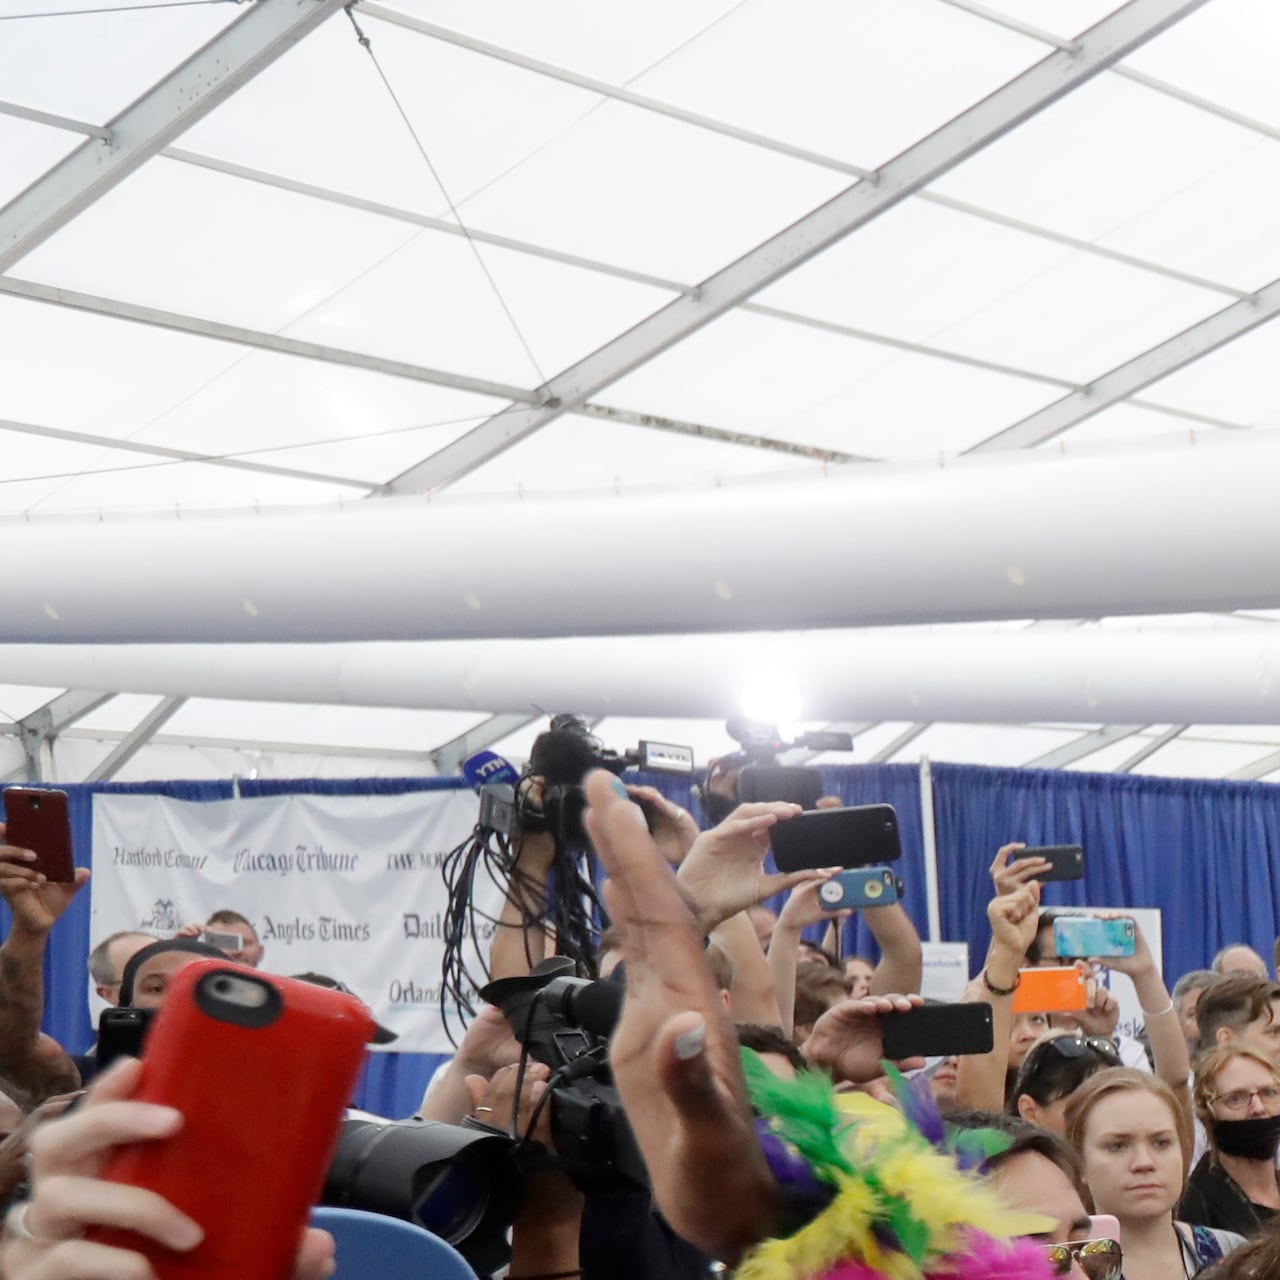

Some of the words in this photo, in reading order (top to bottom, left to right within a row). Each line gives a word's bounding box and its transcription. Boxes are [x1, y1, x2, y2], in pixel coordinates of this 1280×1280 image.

[475, 758, 506, 777] YTN
[294, 845, 360, 873] Tribune
[319, 916, 371, 942] Times
[403, 913, 450, 945] Dail
[389, 979, 449, 1004] Orland
